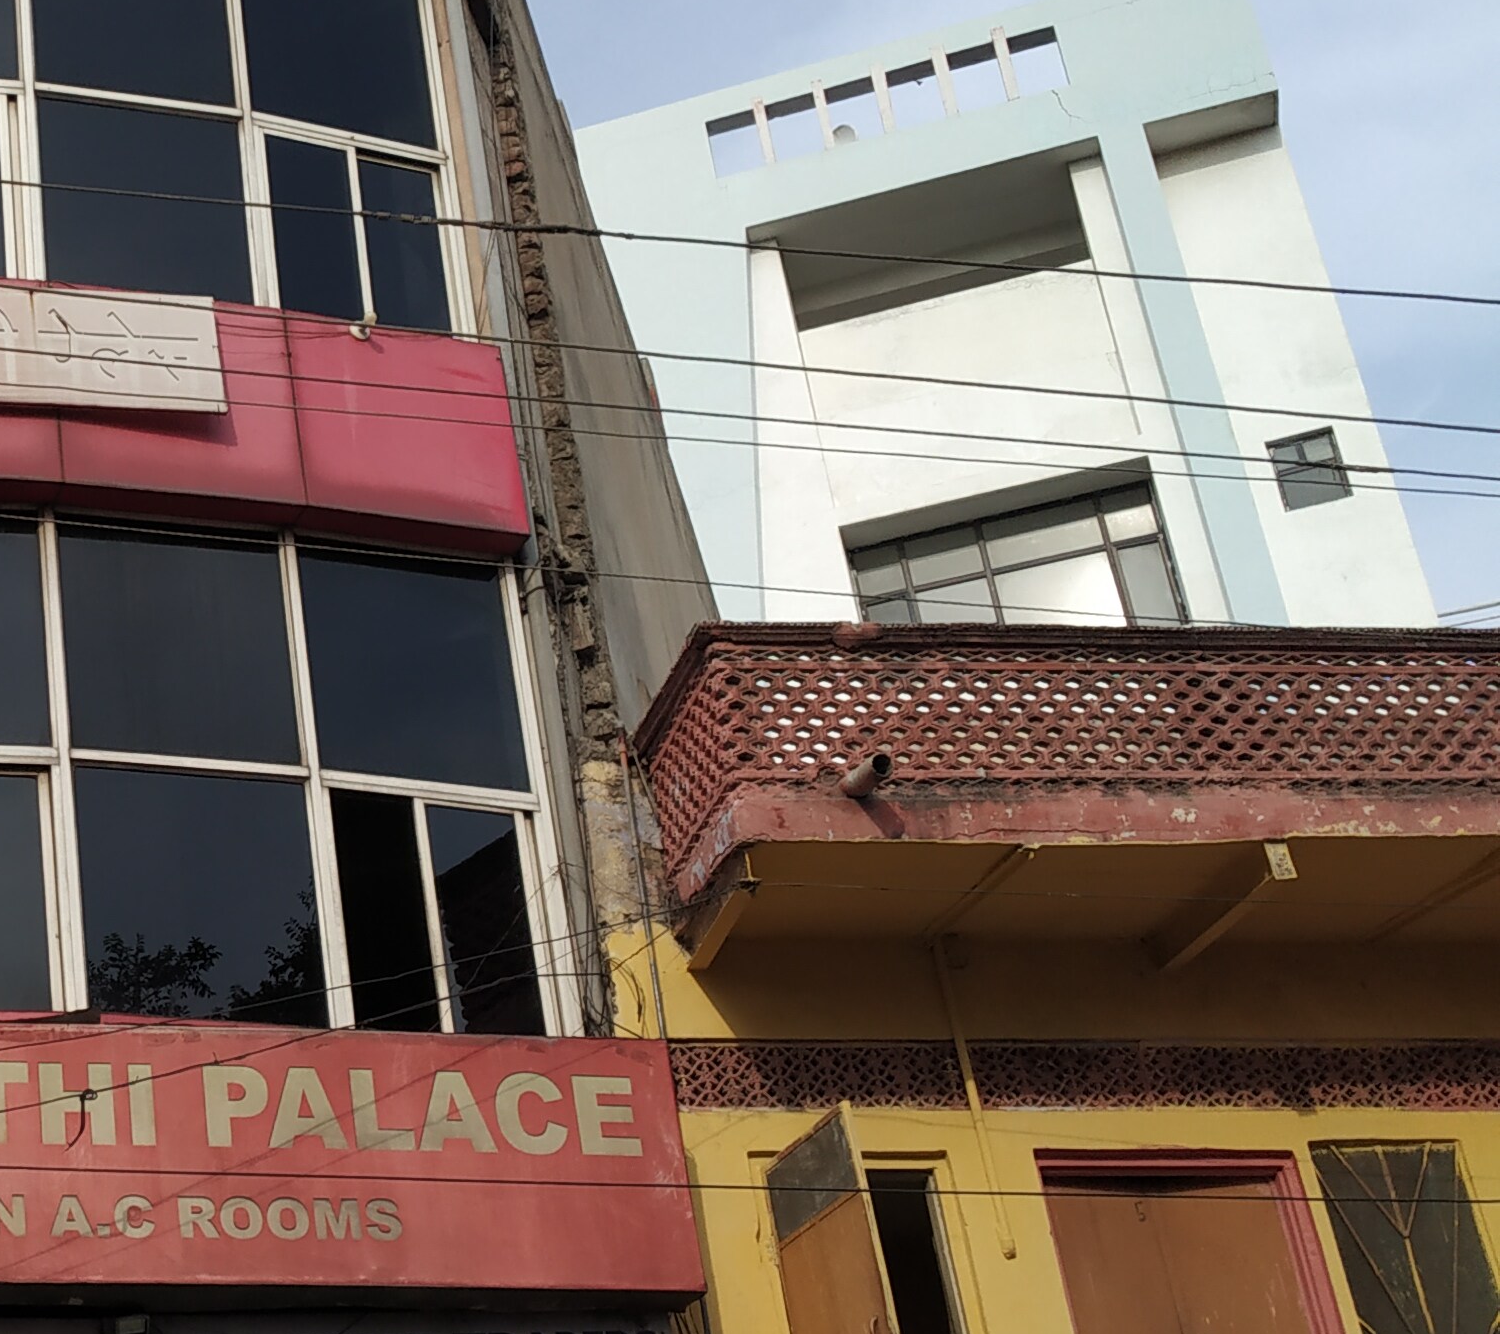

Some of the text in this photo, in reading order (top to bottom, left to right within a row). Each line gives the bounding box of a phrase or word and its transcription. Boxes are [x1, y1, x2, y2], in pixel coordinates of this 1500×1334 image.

[201, 1064, 645, 1157] PALACE
[50, 1194, 156, 1239] A.C
[179, 1195, 404, 1243] ROOMS
